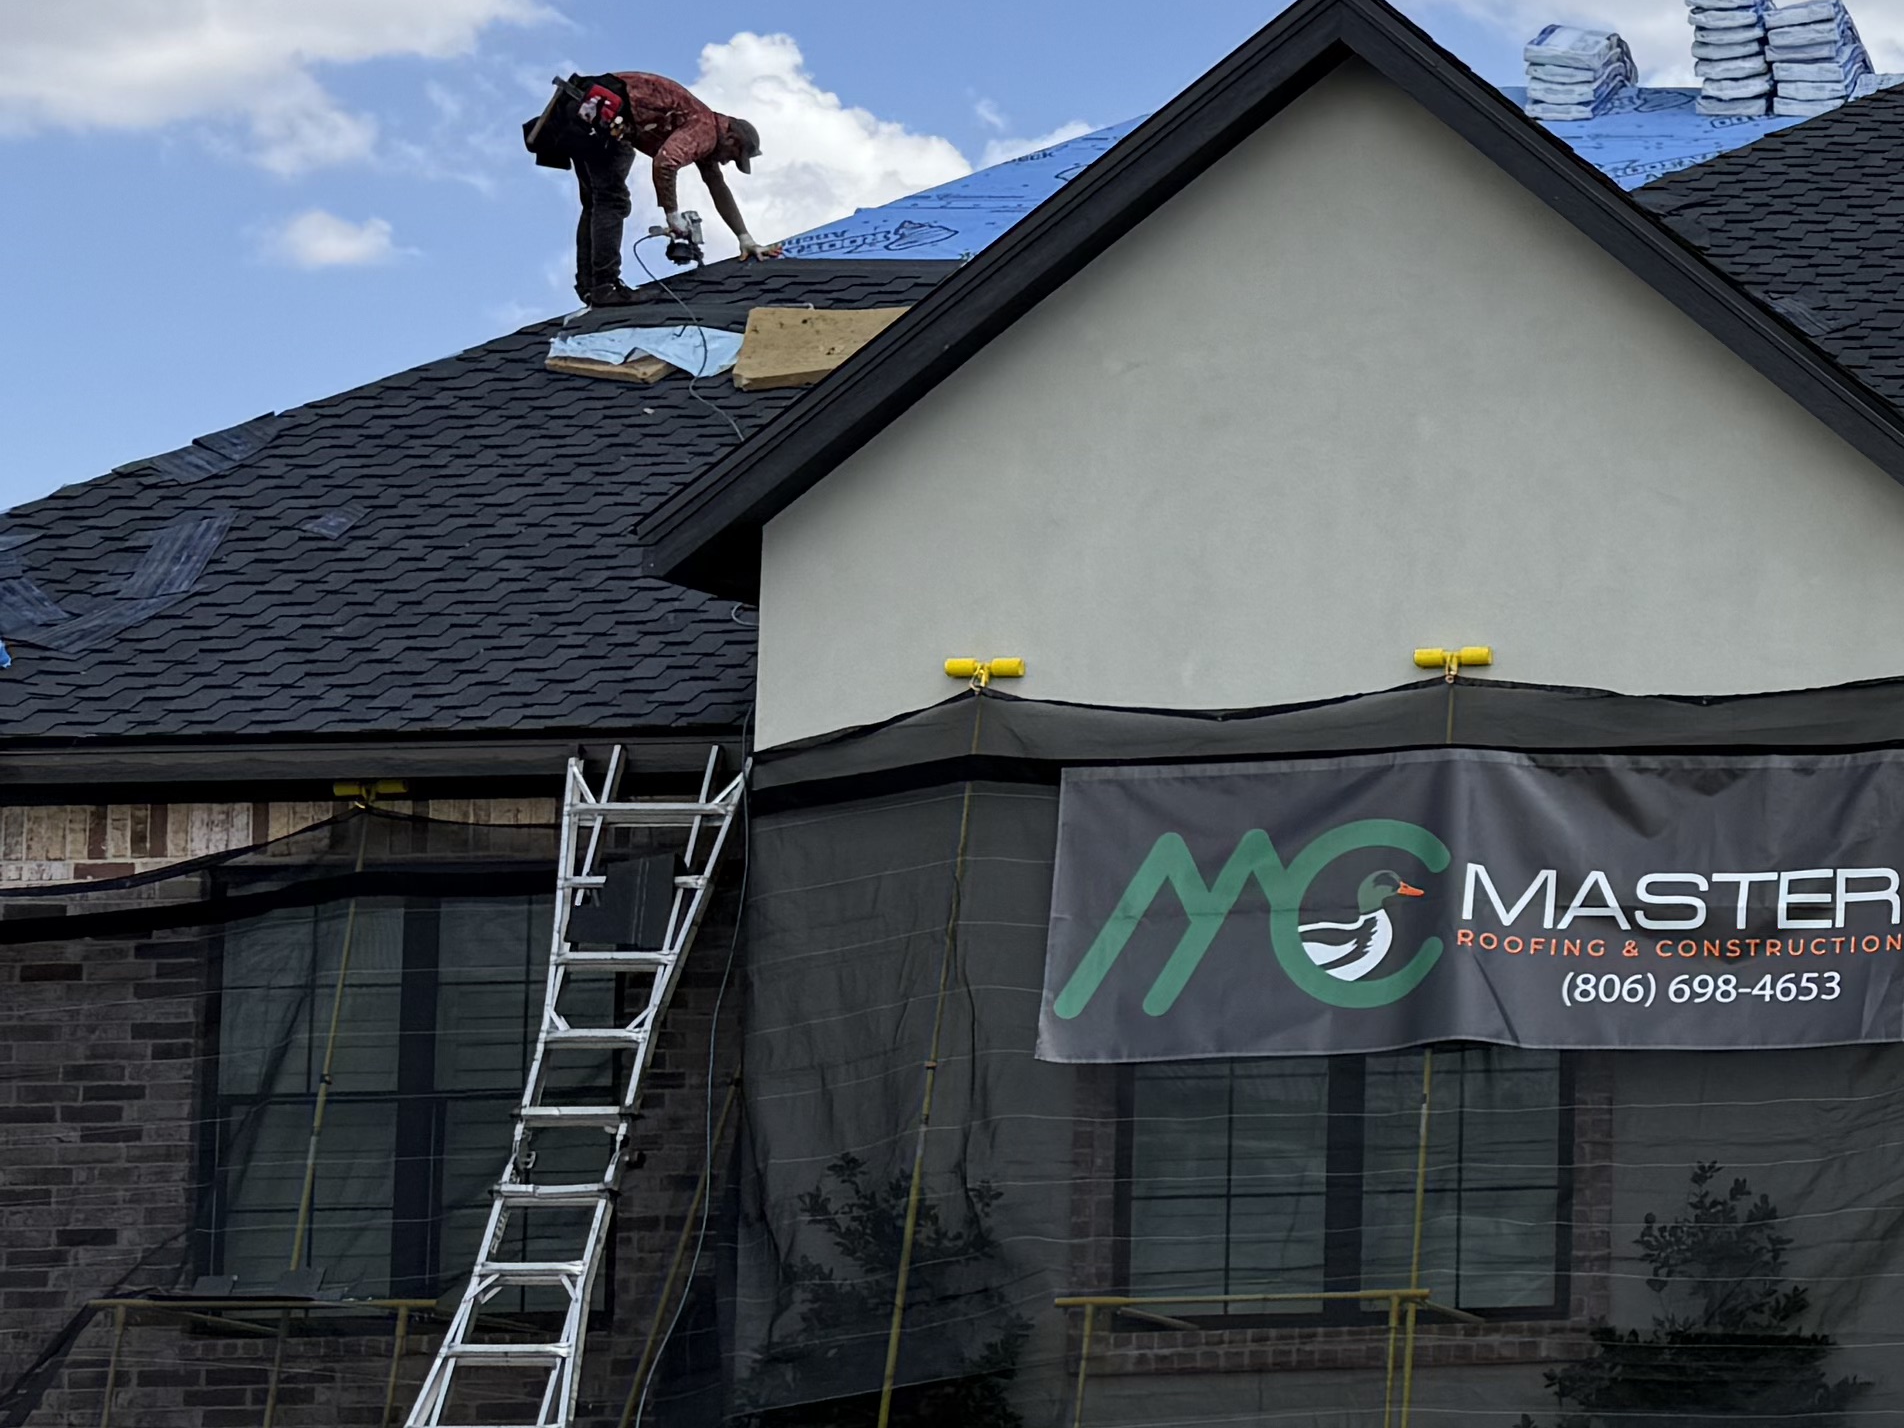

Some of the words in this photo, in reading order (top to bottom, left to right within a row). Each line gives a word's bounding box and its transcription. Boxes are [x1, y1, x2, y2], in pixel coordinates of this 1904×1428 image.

[1461, 862, 1902, 931] MASTER
[1456, 929, 1606, 956] ROOFING
[1622, 938, 1641, 956] &
[1655, 933, 1903, 956] CONSTRUCTION
[1561, 972, 1657, 1008] (806)
[1668, 971, 1841, 1004] 698-4653
